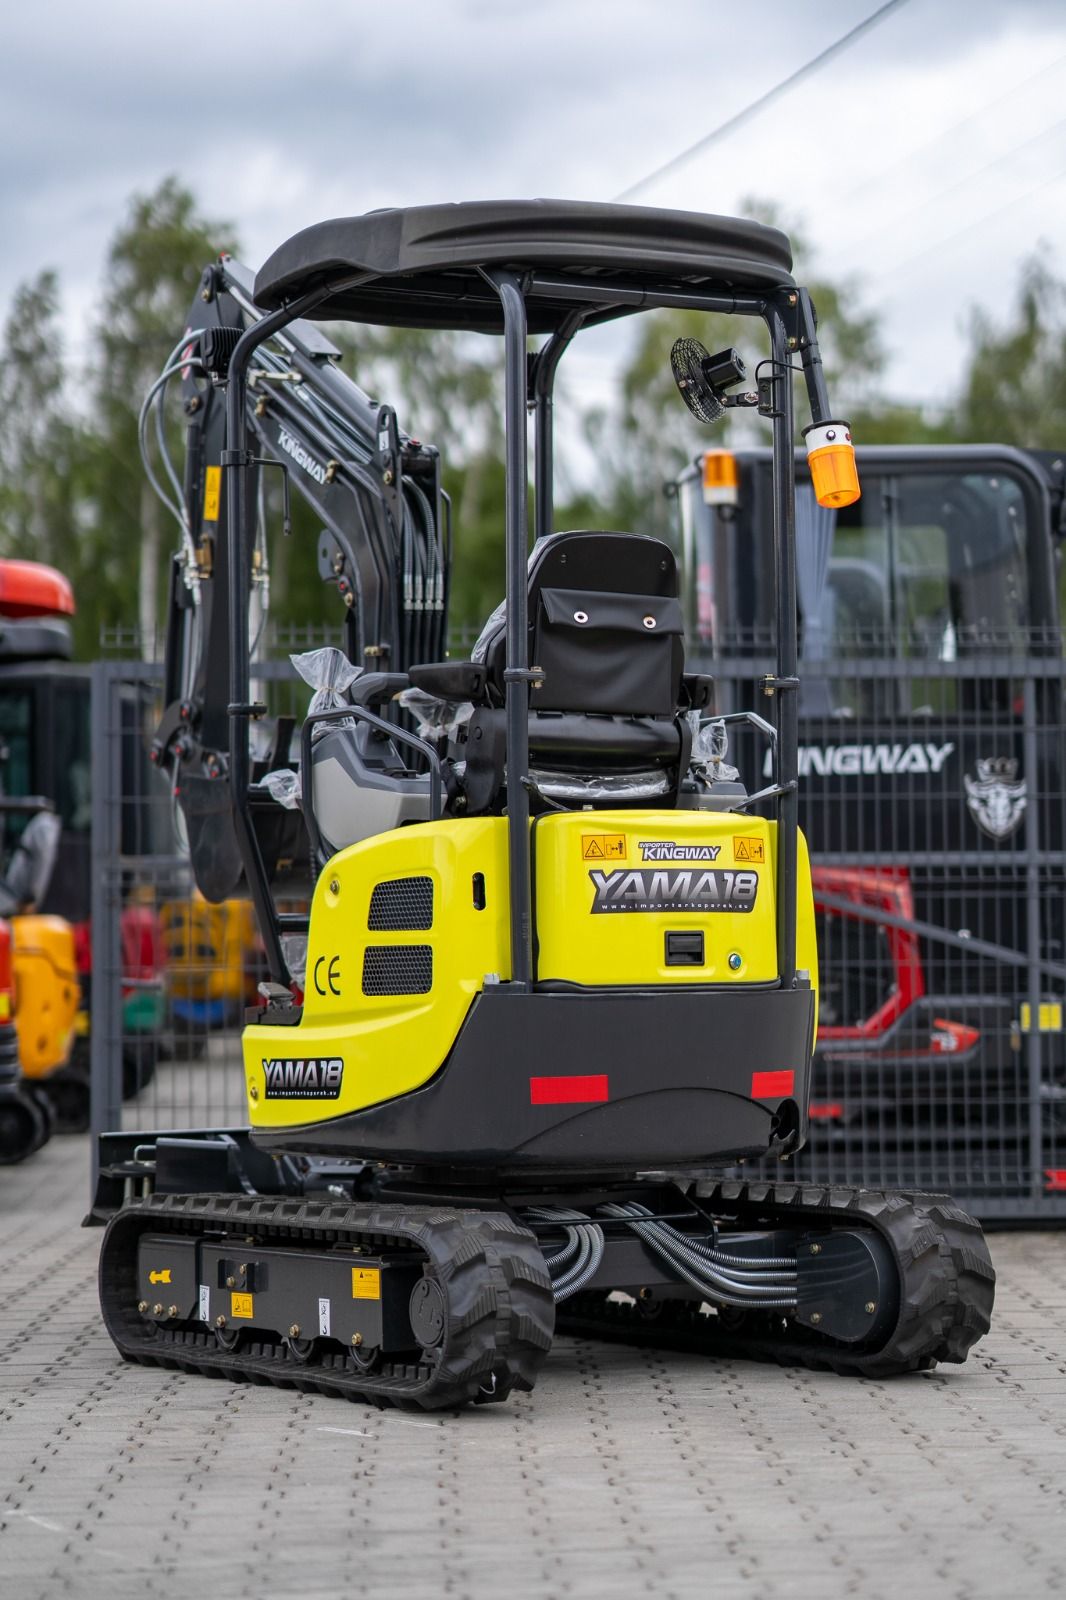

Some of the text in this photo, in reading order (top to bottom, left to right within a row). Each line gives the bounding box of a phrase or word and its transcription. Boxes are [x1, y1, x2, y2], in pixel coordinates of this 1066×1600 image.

[643, 847, 719, 860] KINGWAY
[592, 871, 757, 900] YAMA18
[263, 1060, 343, 1087] YAMA18
